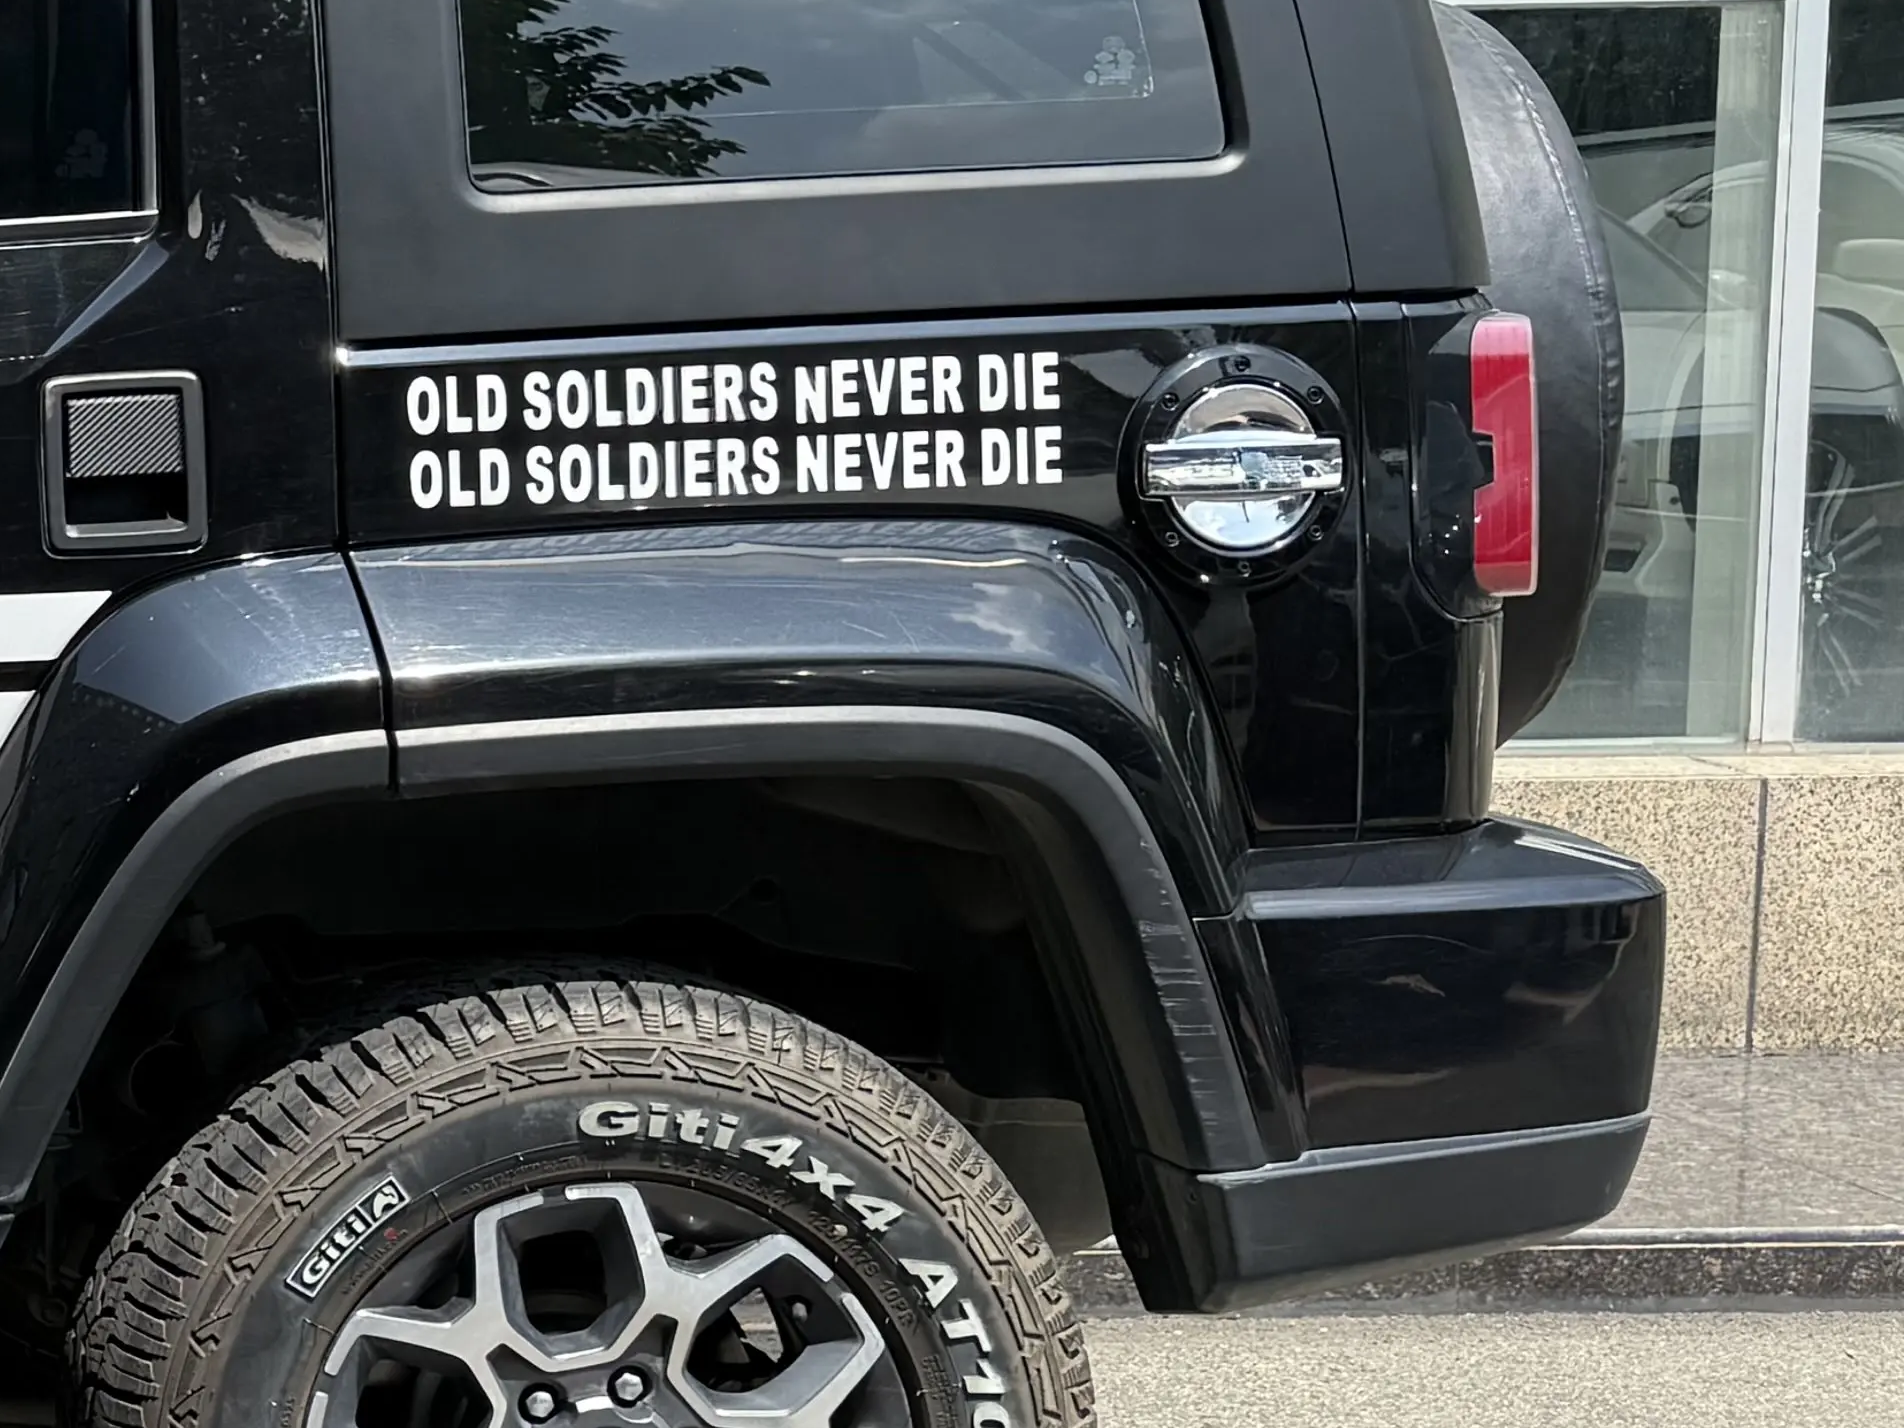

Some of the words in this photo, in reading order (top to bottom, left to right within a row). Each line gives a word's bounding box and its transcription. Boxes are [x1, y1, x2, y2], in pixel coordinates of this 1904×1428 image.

[405, 370, 508, 436] OLD
[520, 362, 779, 431] SOLDIERS
[793, 354, 962, 424] NEVER
[978, 351, 1060, 415] DIE
[407, 446, 510, 510] OLD
[523, 437, 781, 503] SOLDIERS
[795, 430, 966, 494] NEVER
[979, 425, 1063, 487] DIE
[301, 1213, 367, 1286] Giti
